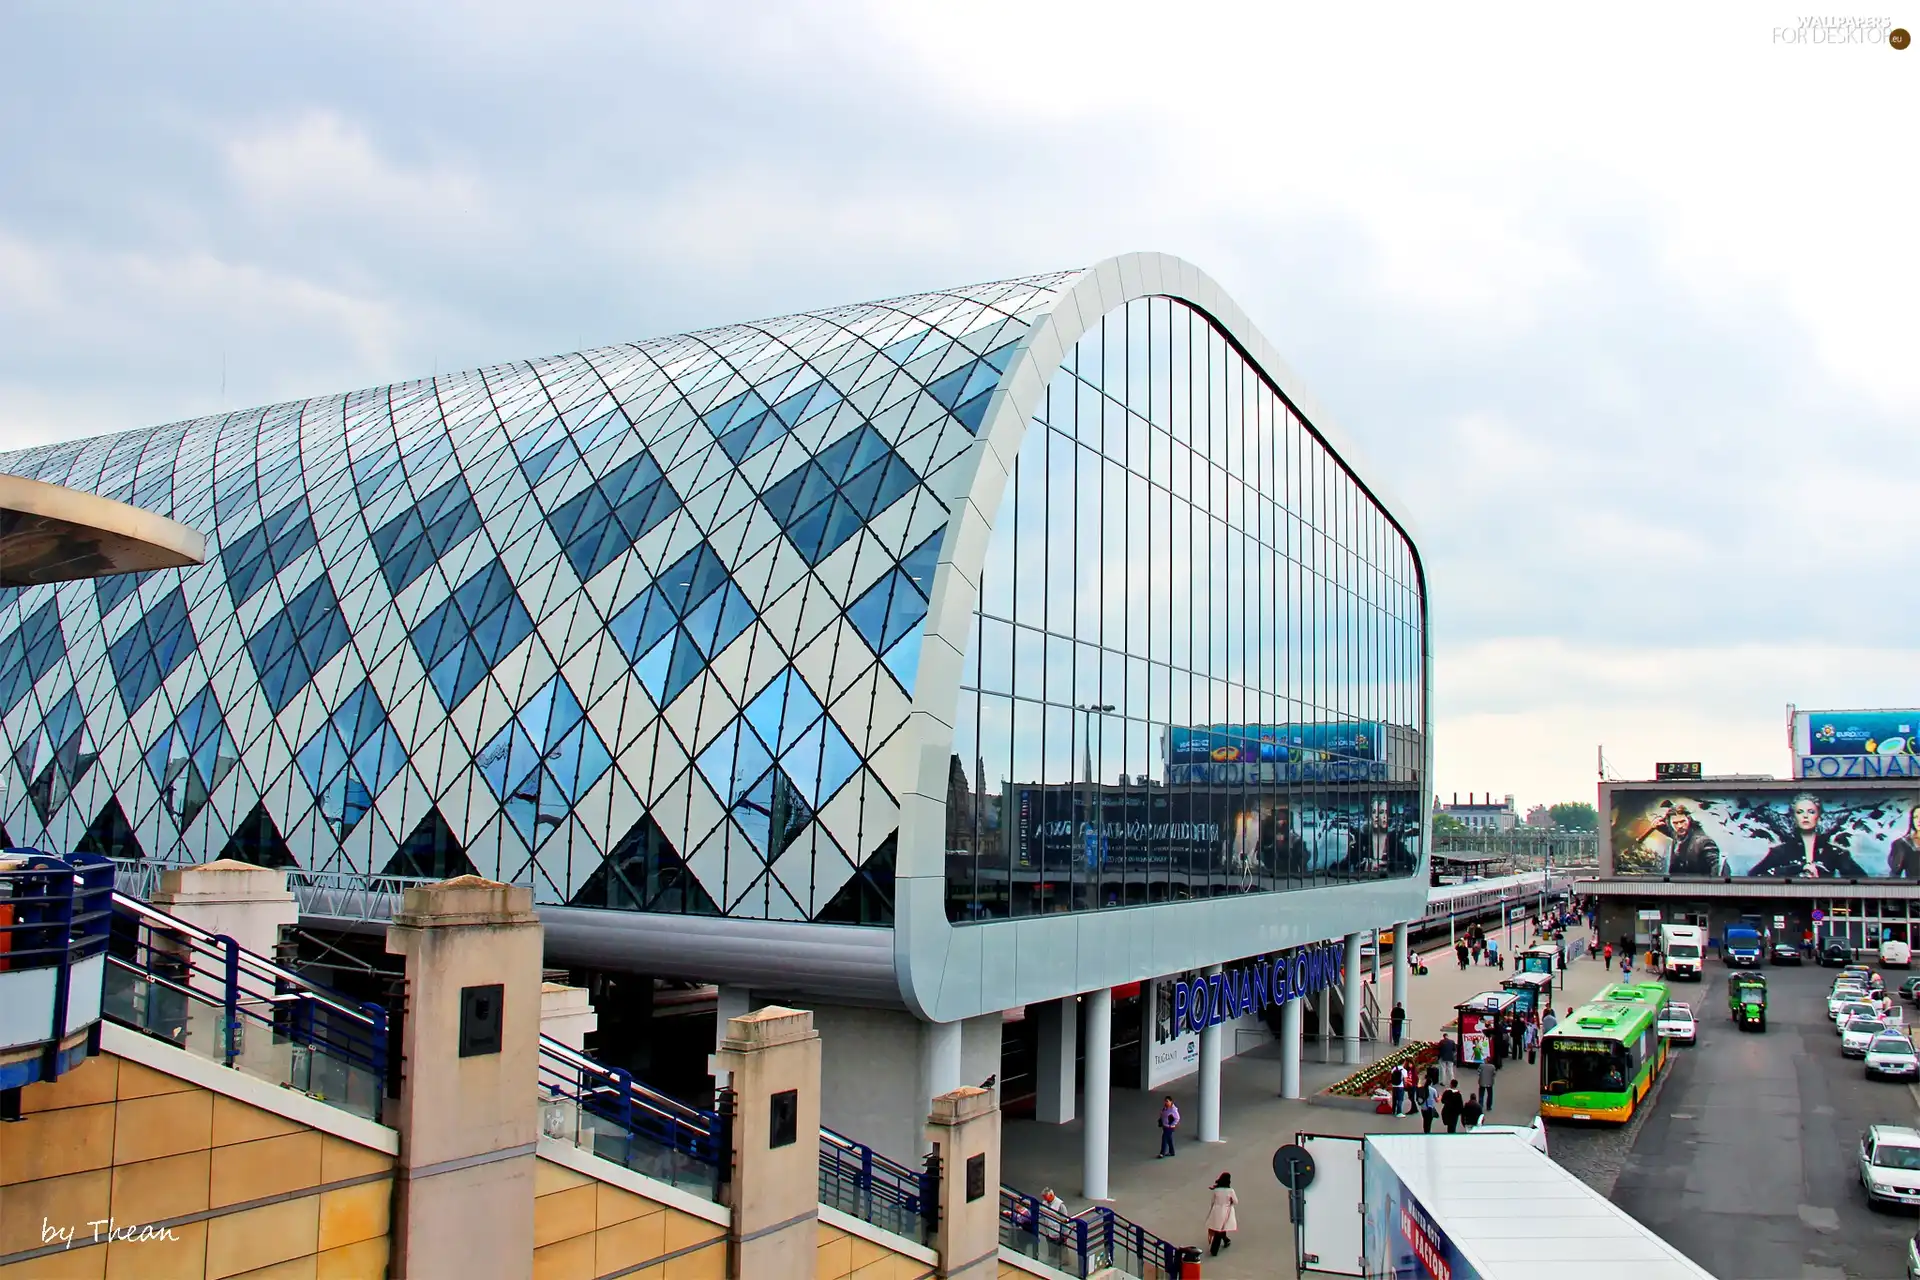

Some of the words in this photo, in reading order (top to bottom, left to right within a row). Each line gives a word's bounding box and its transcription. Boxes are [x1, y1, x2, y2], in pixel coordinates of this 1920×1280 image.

[1660, 763, 1699, 773] 12:29
[1174, 955, 1268, 1038] POZNAŃ
[1272, 943, 1345, 1006] GŁÓWNY
